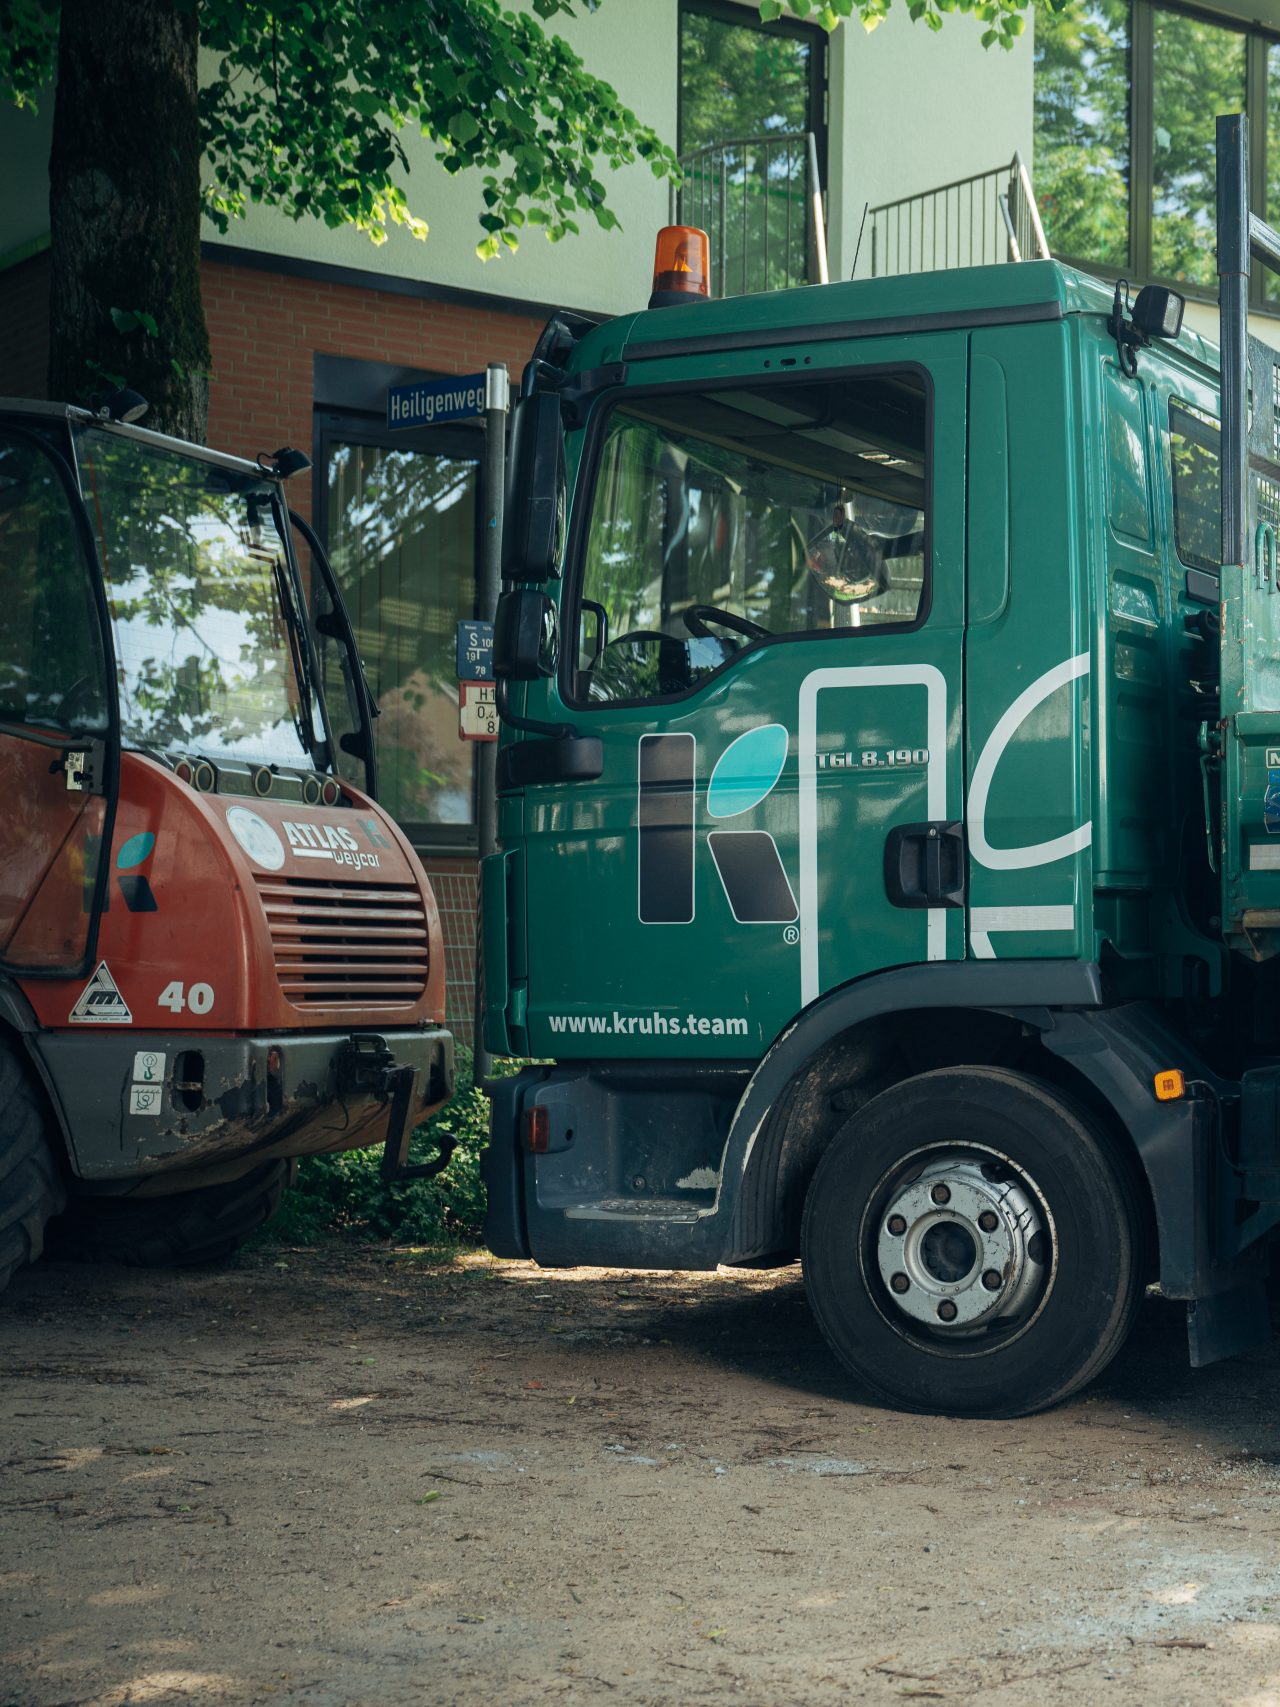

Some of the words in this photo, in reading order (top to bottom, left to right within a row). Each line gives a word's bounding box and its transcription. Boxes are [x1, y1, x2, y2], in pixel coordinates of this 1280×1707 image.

[391, 386, 485, 421] Heiligenweg
[816, 752, 859, 769] TGL
[861, 748, 930, 768] 8.190
[282, 821, 358, 851] ATLAS
[157, 981, 215, 1015] 40
[548, 1011, 749, 1035] www.kruhs.team
